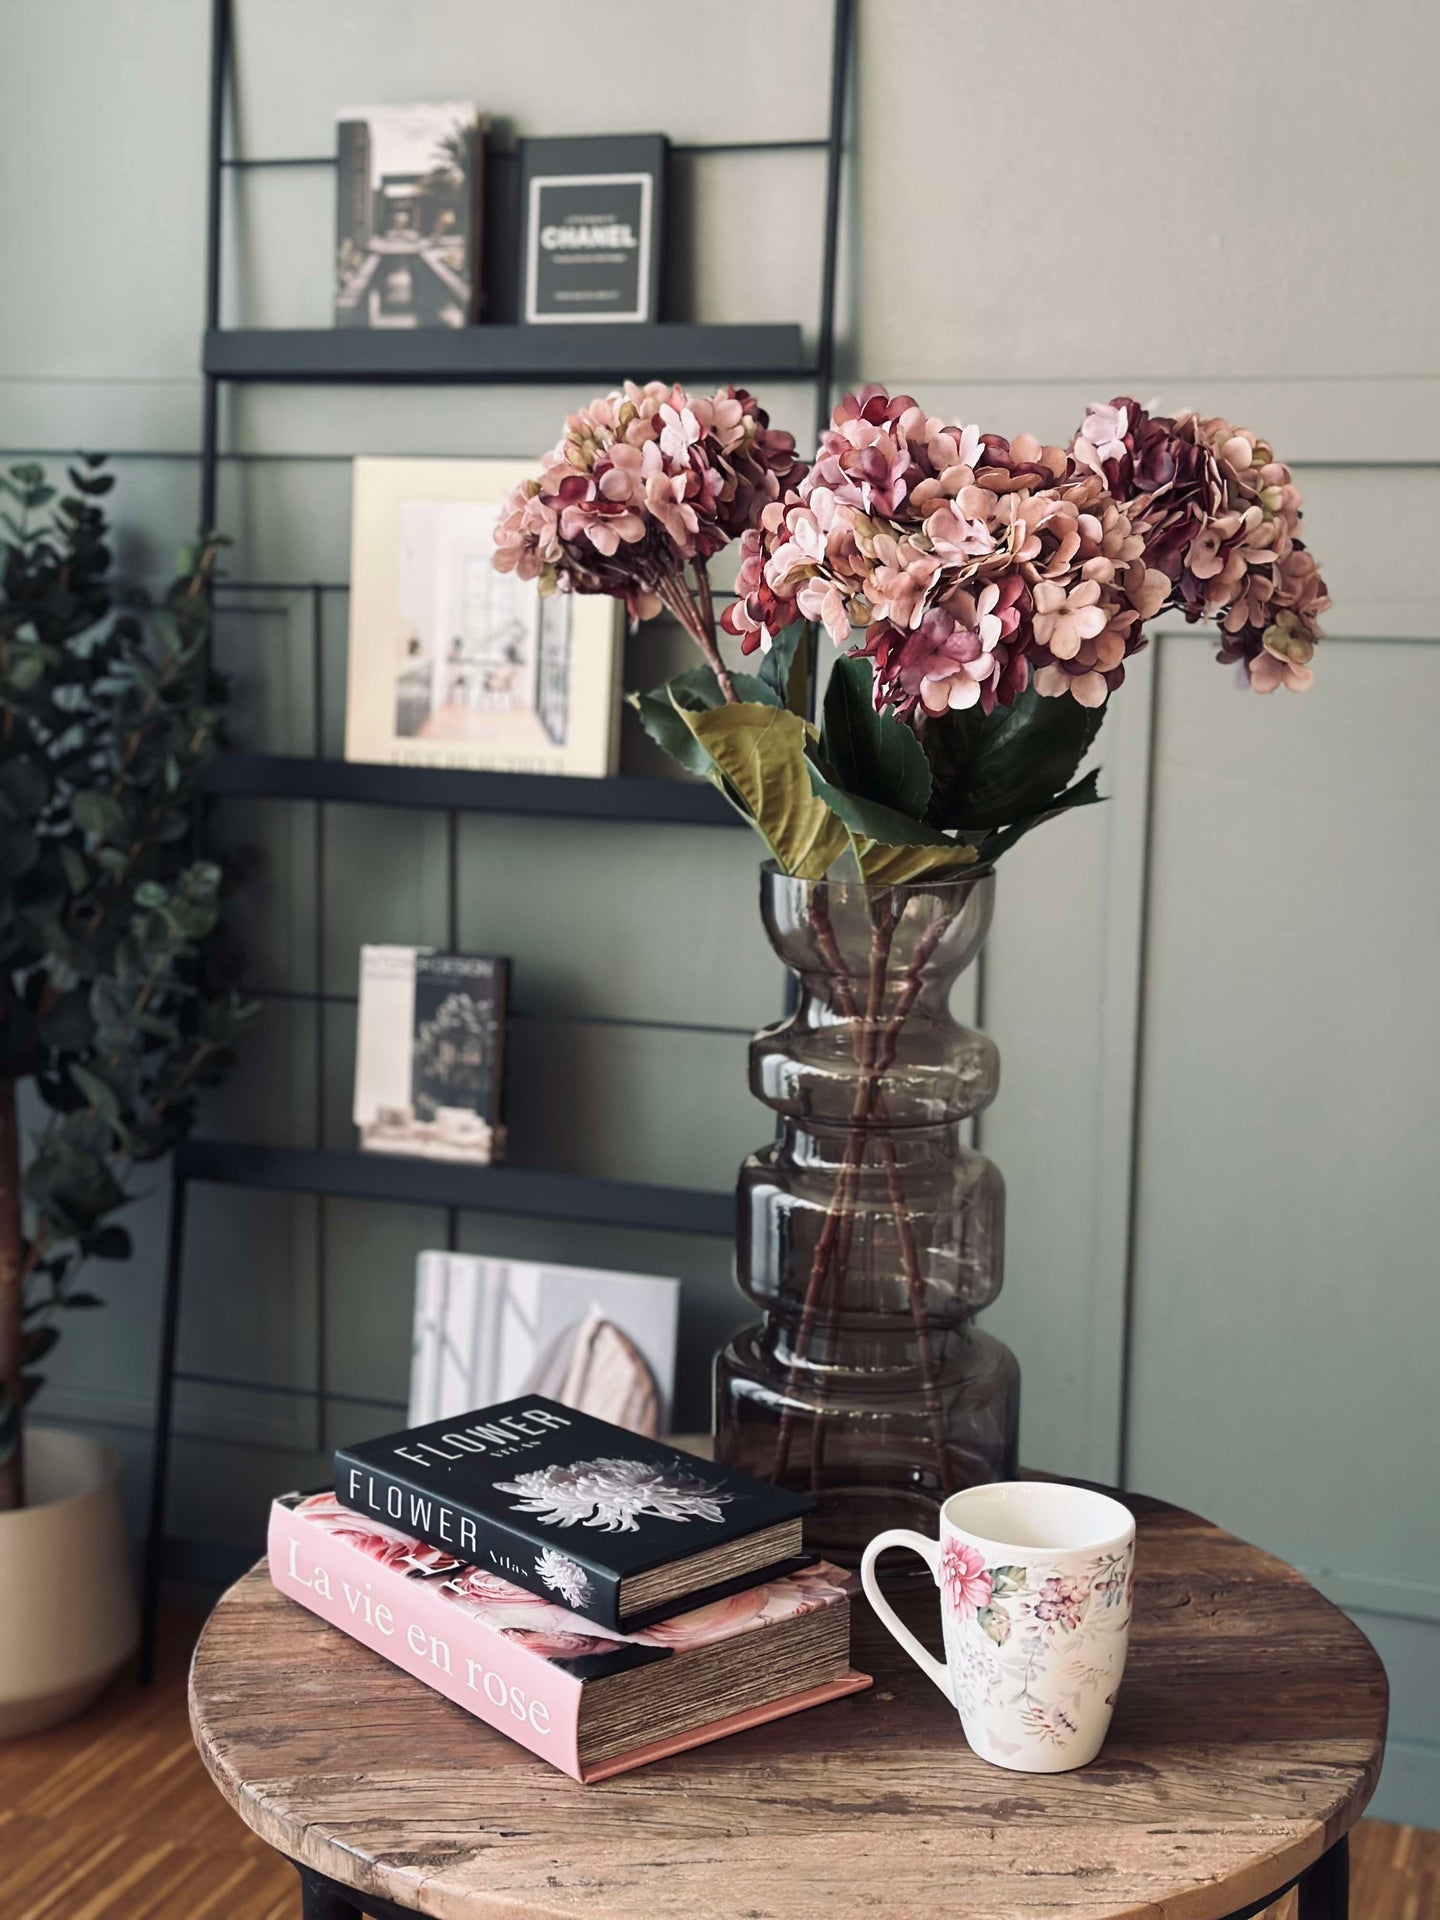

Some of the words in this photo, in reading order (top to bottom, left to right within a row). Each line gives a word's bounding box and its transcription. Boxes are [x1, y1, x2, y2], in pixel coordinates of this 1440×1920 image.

[541, 225, 638, 250] CHANEL
[393, 1410, 572, 1467] FLOWER
[349, 1468, 477, 1553] FLOWER
[287, 1536, 334, 1600] La
[342, 1582, 395, 1637] vie
[407, 1624, 454, 1677] en
[465, 1657, 551, 1735] rose
